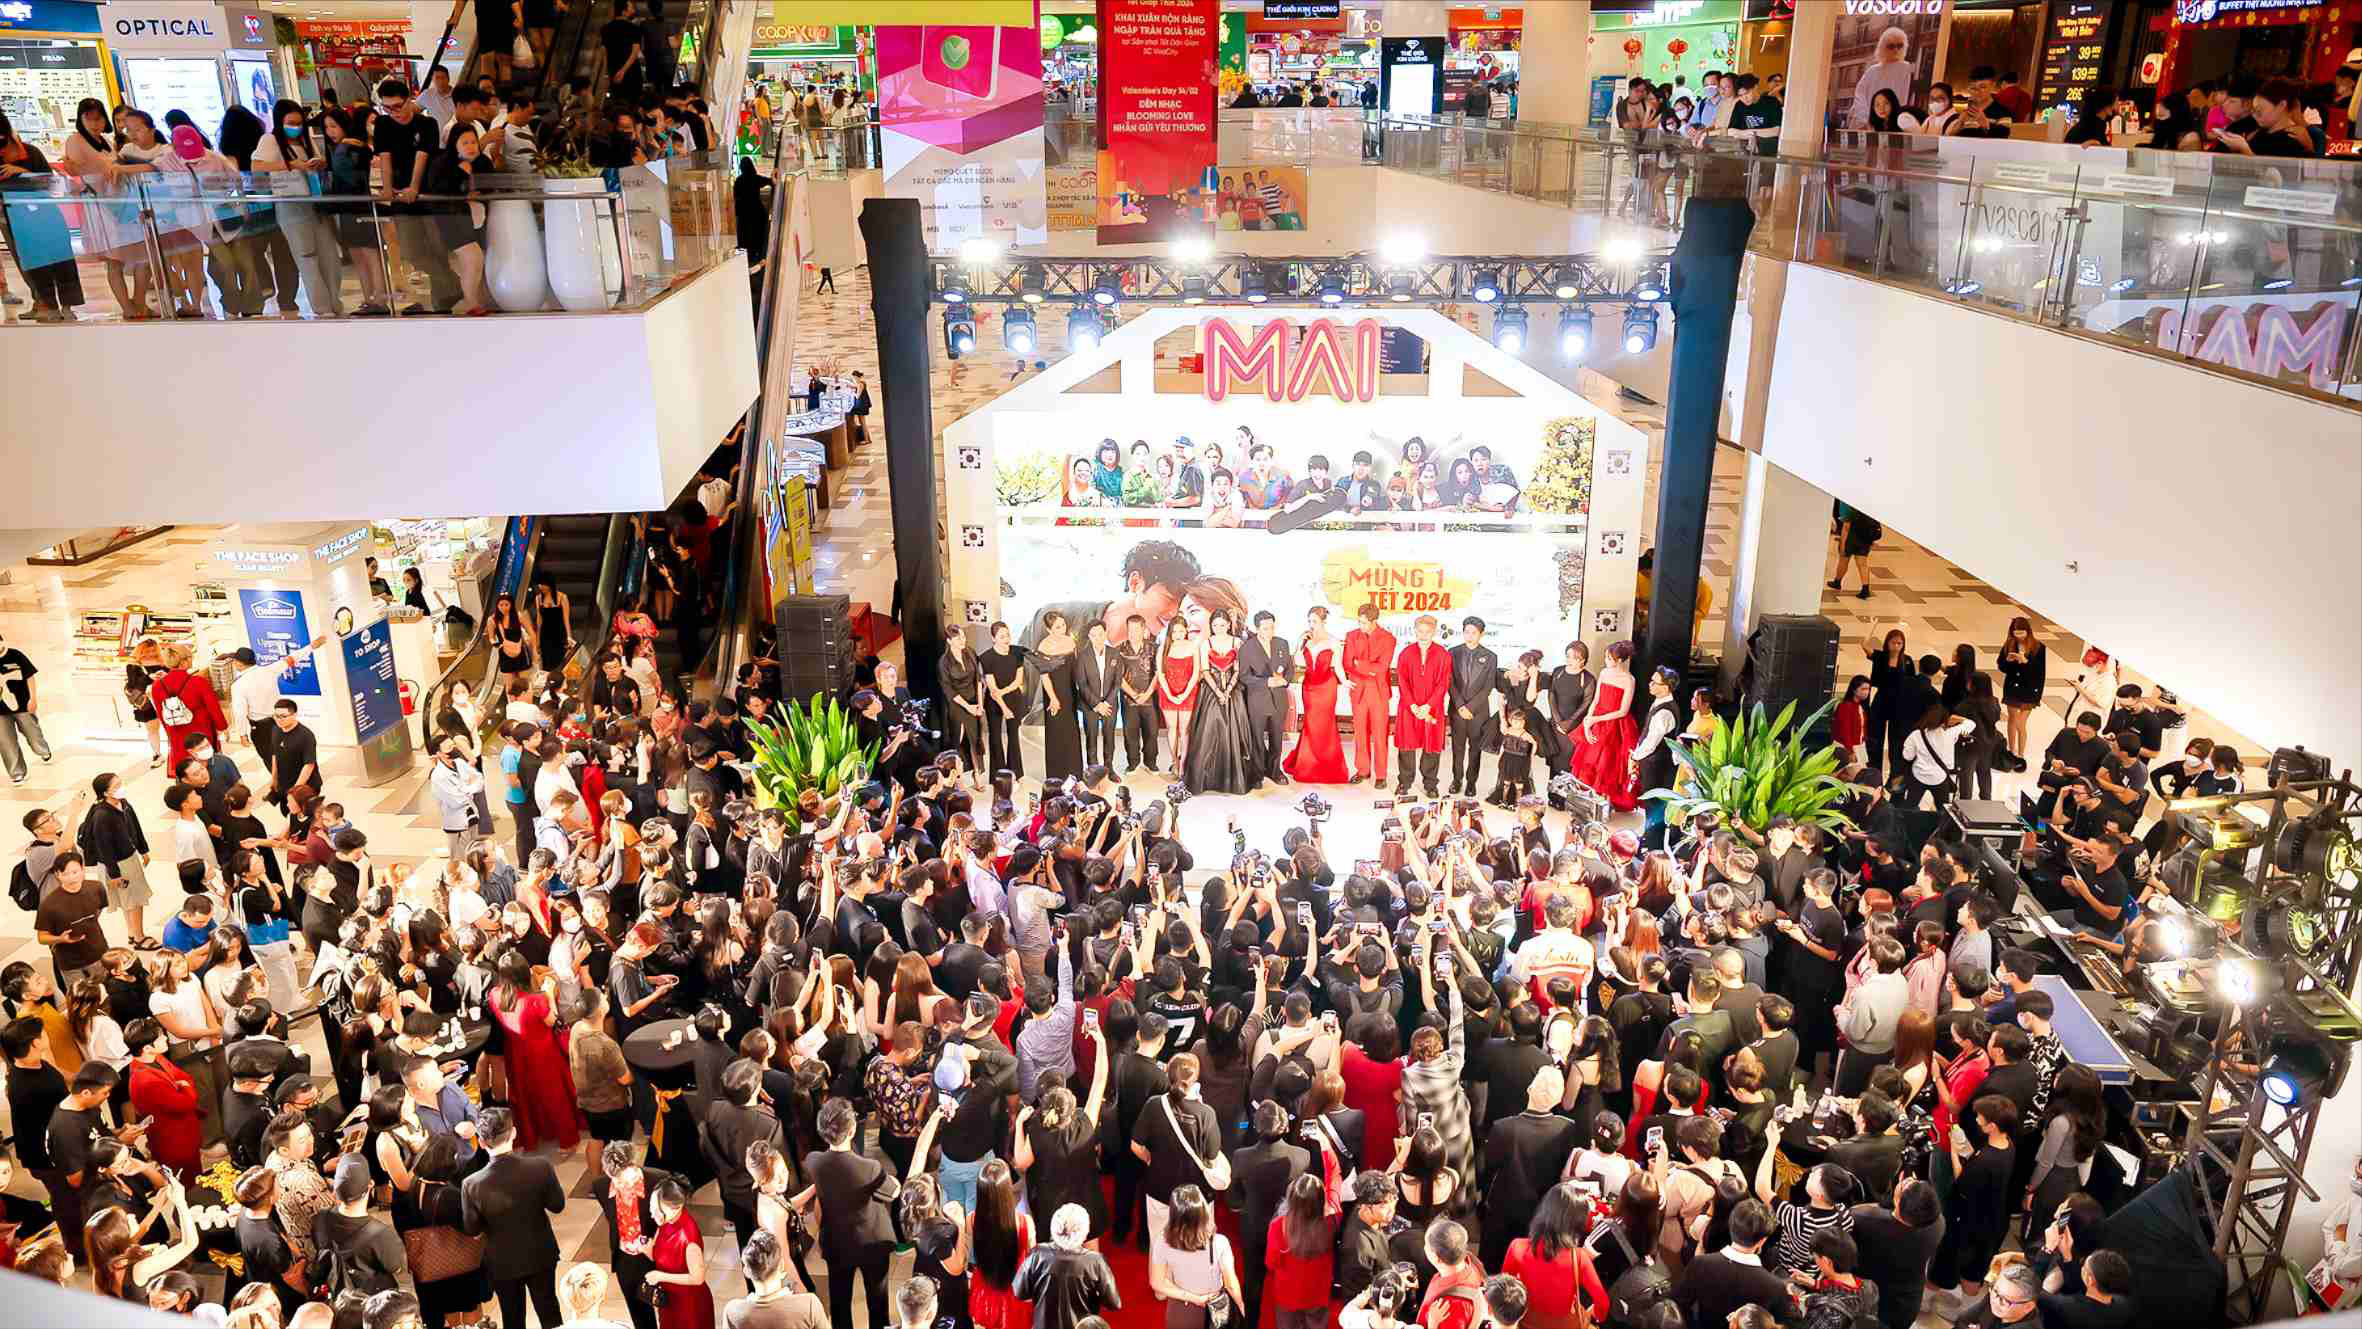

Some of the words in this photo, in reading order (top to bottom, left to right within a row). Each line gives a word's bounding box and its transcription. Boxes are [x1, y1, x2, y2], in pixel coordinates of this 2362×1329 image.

[2219, 1, 2243, 10] BUFFET
[1114, 12, 1136, 22] KHAI
[1137, 11, 1160, 22] XUÂN
[1161, 12, 1180, 25] RỘN
[1181, 12, 1205, 24] RÀNG
[116, 19, 214, 36] OPTICAL
[1113, 24, 1137, 37] NGẬP
[1140, 25, 1162, 35] TRÀN
[1164, 25, 1182, 36] QUÀ
[1184, 25, 1206, 38] TẶNG
[2078, 46, 2091, 59] 39
[2072, 67, 2088, 80] 139
[1162, 87, 1177, 97] Day
[1138, 97, 1157, 109] ĐÊM
[1158, 99, 1183, 111] NHẠC
[1126, 112, 1171, 121] BLOOMING
[1173, 111, 1194, 121] LOVE
[1155, 121, 1171, 132] YÊU
[1203, 316, 1381, 402] MAI
[1348, 562, 1425, 588] MÙNG
[1433, 568, 1444, 588] 1
[1368, 587, 1399, 611] TẾT
[1403, 592, 1451, 611] 2024
[1167, 1016, 1196, 1048] 7
